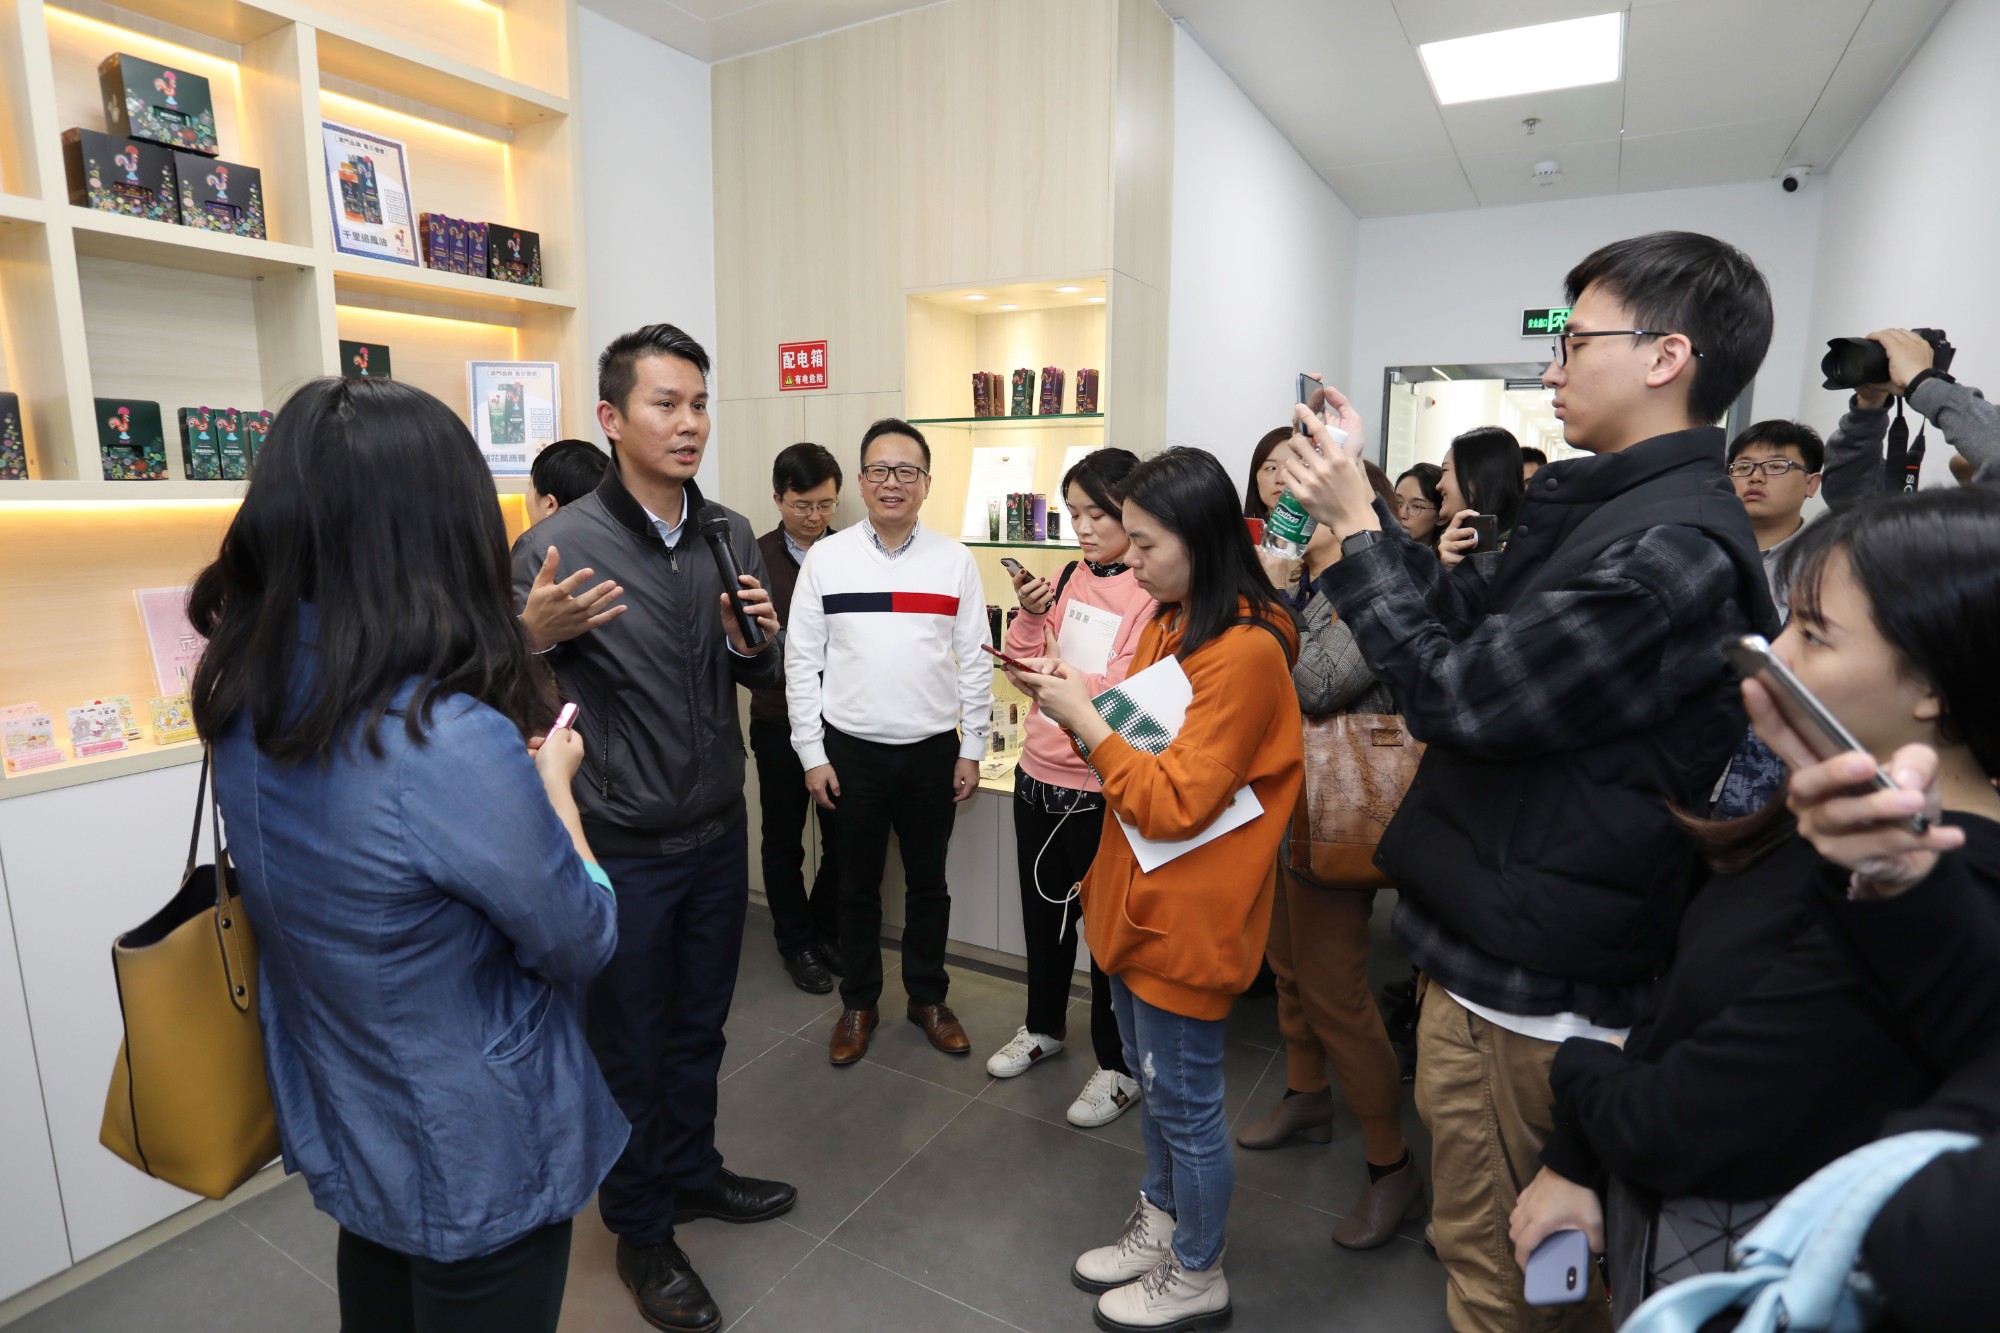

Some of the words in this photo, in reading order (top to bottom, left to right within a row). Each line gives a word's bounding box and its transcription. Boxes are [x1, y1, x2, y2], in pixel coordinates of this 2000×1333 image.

[342, 229, 388, 247] 千里追風油
[782, 348, 824, 370] 配电箱
[794, 372, 824, 385] 有电危险
